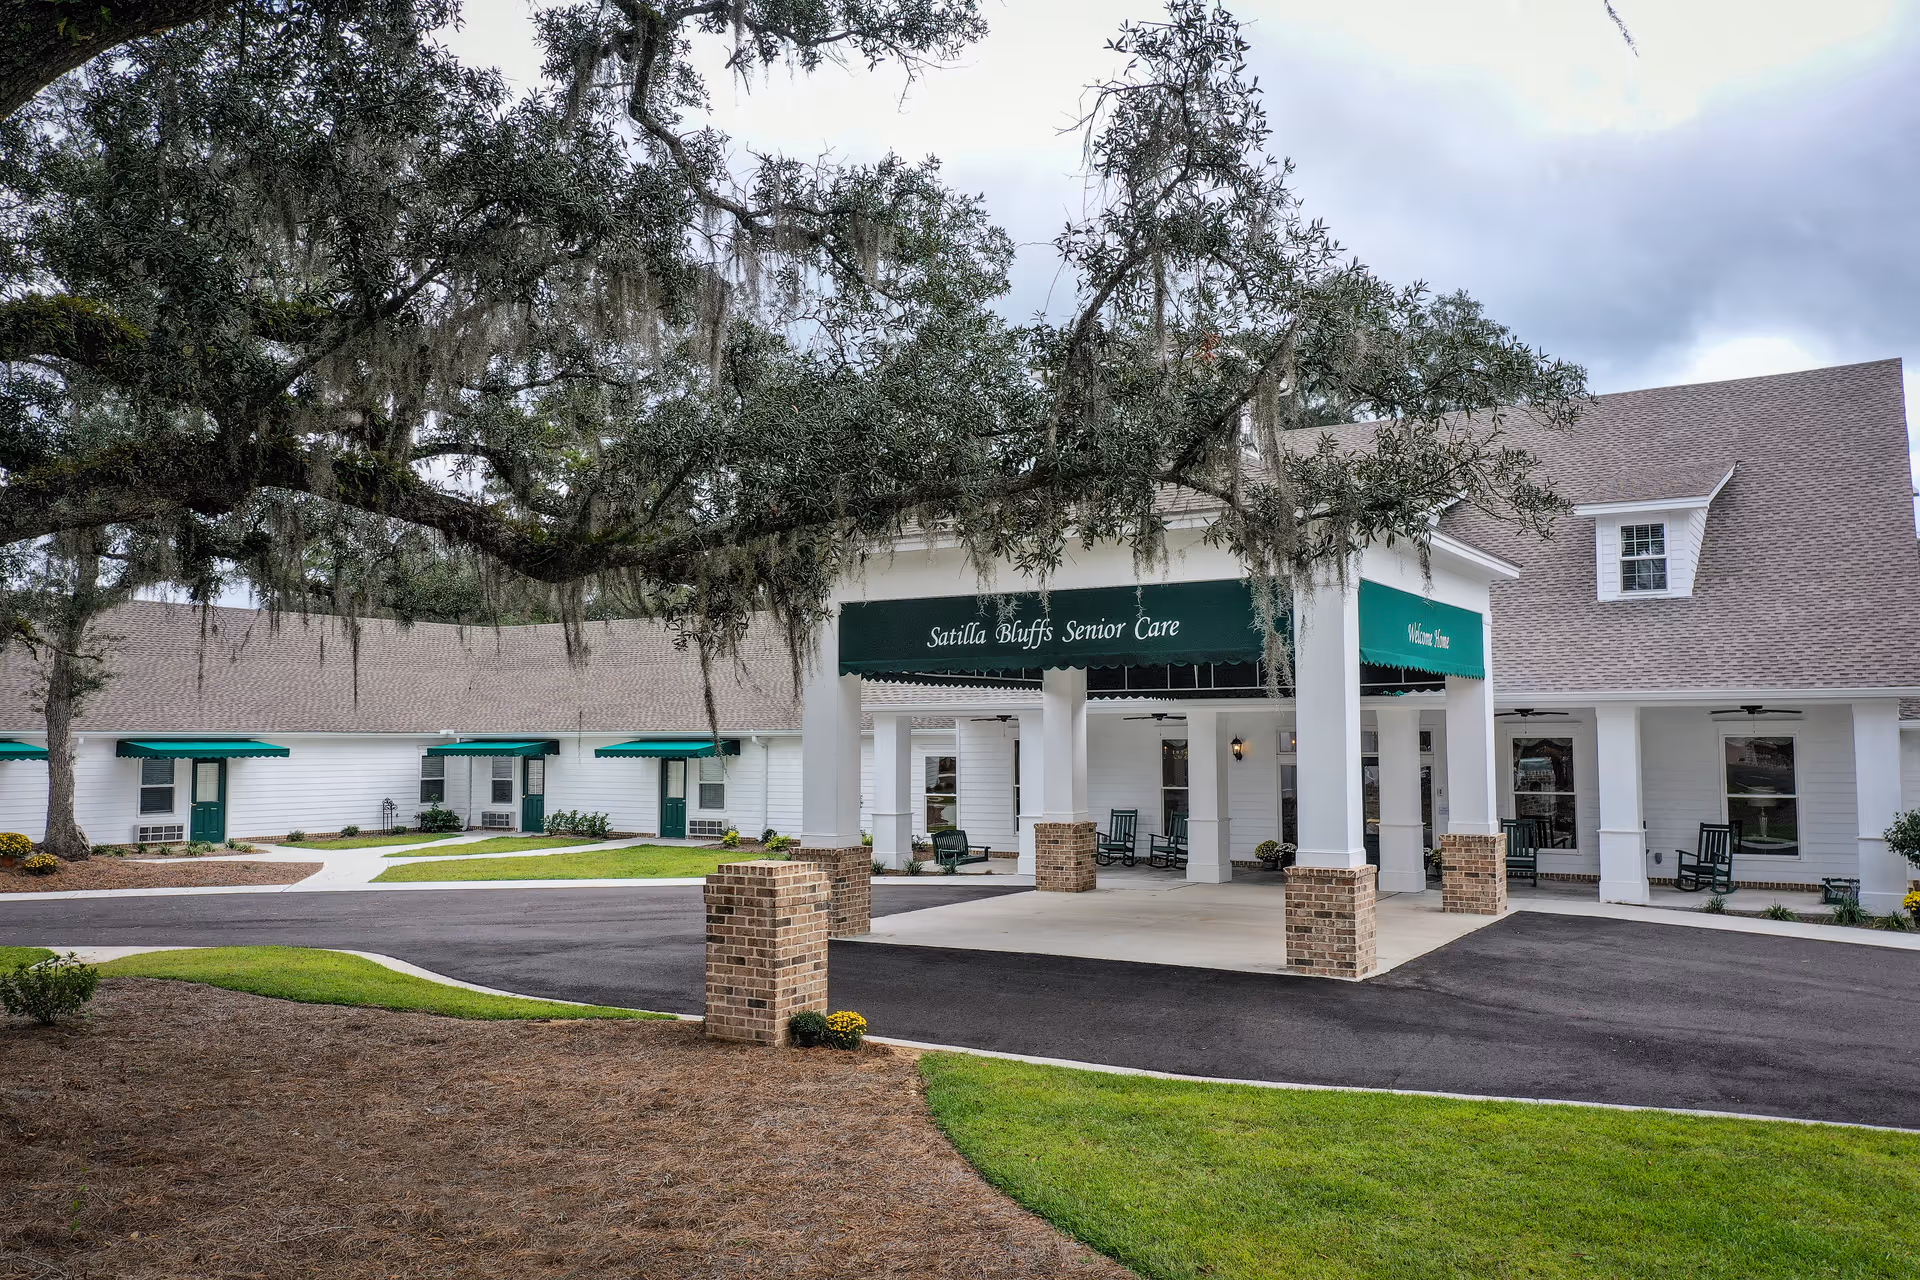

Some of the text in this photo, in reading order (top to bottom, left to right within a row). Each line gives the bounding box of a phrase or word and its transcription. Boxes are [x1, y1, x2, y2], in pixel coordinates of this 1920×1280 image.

[926, 616, 1180, 650] Satilla Bluffs Senior Care
[1407, 621, 1450, 650] Welcome Home
